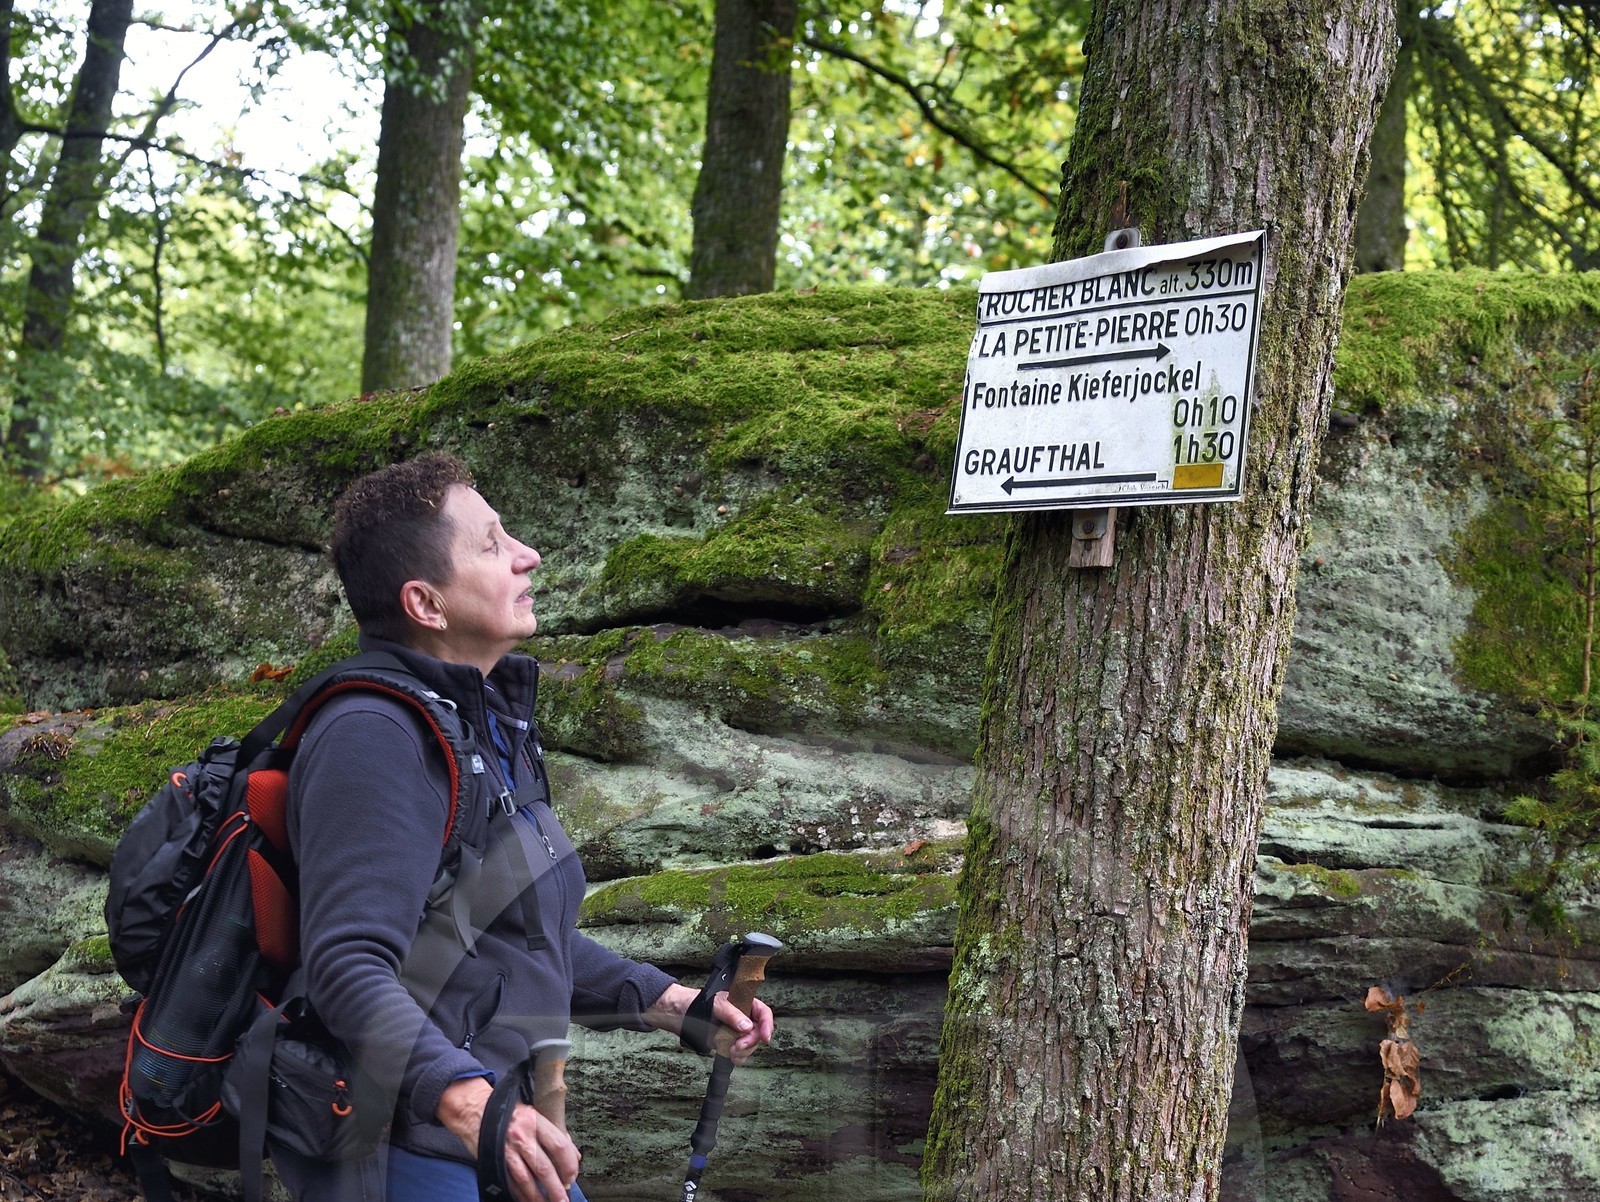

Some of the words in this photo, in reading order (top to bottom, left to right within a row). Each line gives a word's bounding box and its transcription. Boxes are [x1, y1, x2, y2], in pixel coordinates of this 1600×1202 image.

[985, 282, 1074, 317] ROCHER
[1080, 267, 1157, 304] BLANC
[1160, 274, 1184, 295] alt.
[1184, 258, 1254, 292] 330m
[978, 331, 1007, 358] LA
[1013, 308, 1180, 356] PETITE-PIERRE
[1184, 302, 1248, 337] 0h30
[971, 378, 1063, 410] Fontaine
[1067, 360, 1202, 403] Kieferjockel
[1172, 395, 1238, 428] 0h10
[964, 440, 1106, 476] GRAUFTHAL
[1173, 431, 1236, 465] 1h30
